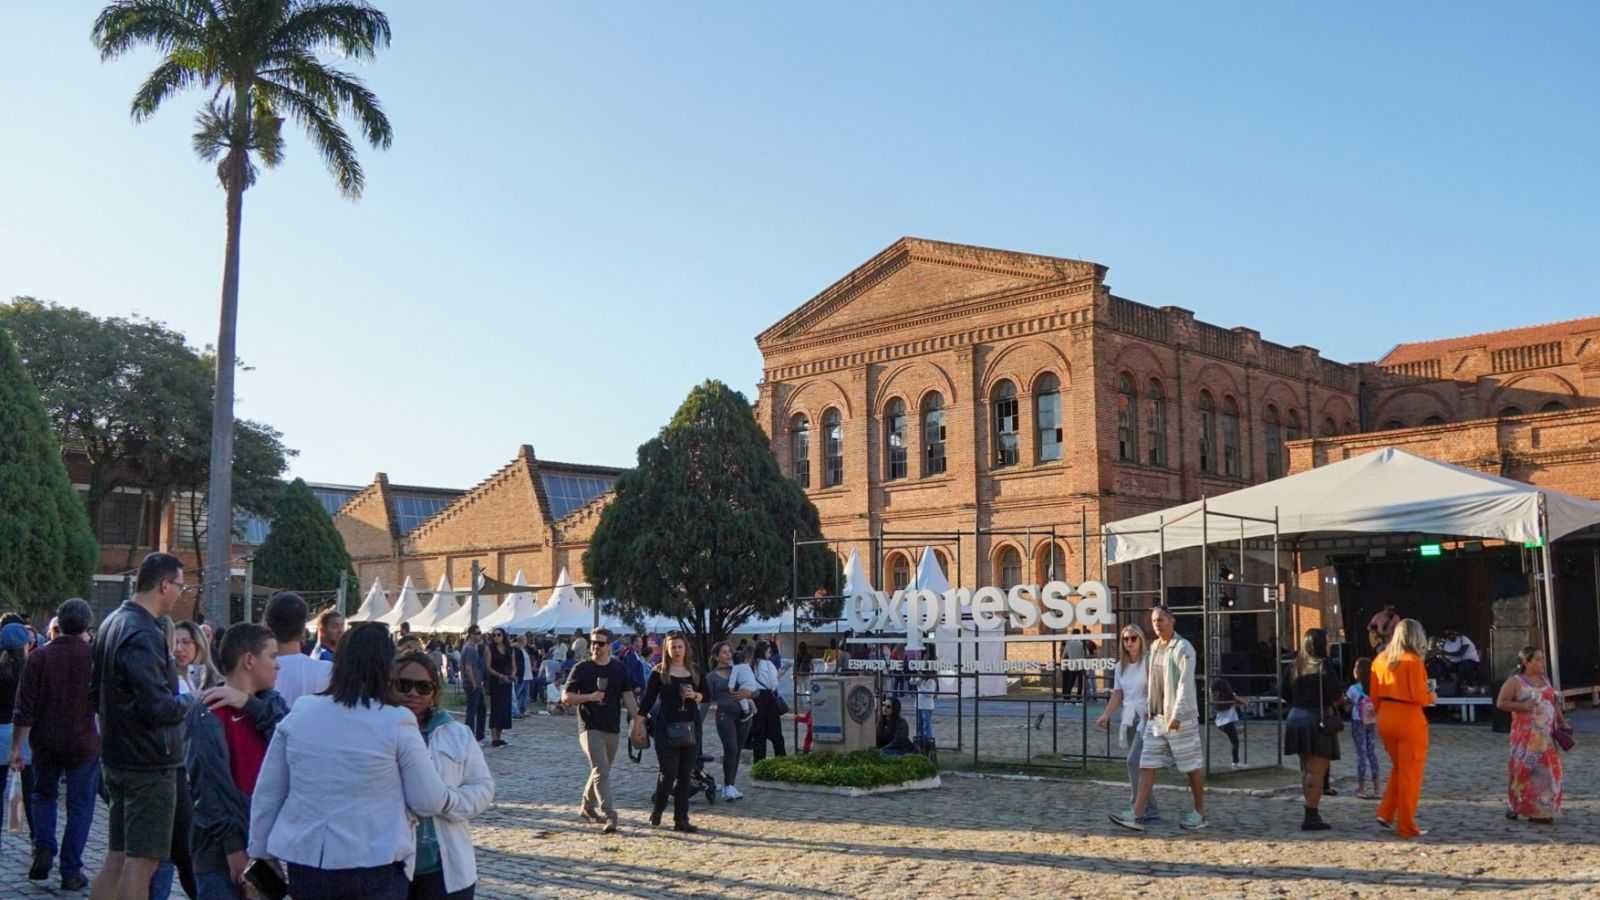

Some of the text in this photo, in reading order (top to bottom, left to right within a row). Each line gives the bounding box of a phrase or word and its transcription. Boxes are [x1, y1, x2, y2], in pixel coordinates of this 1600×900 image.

[847, 580, 1116, 650] expressa
[889, 659, 904, 671] DE
[1060, 658, 1116, 671] FUTUROS
